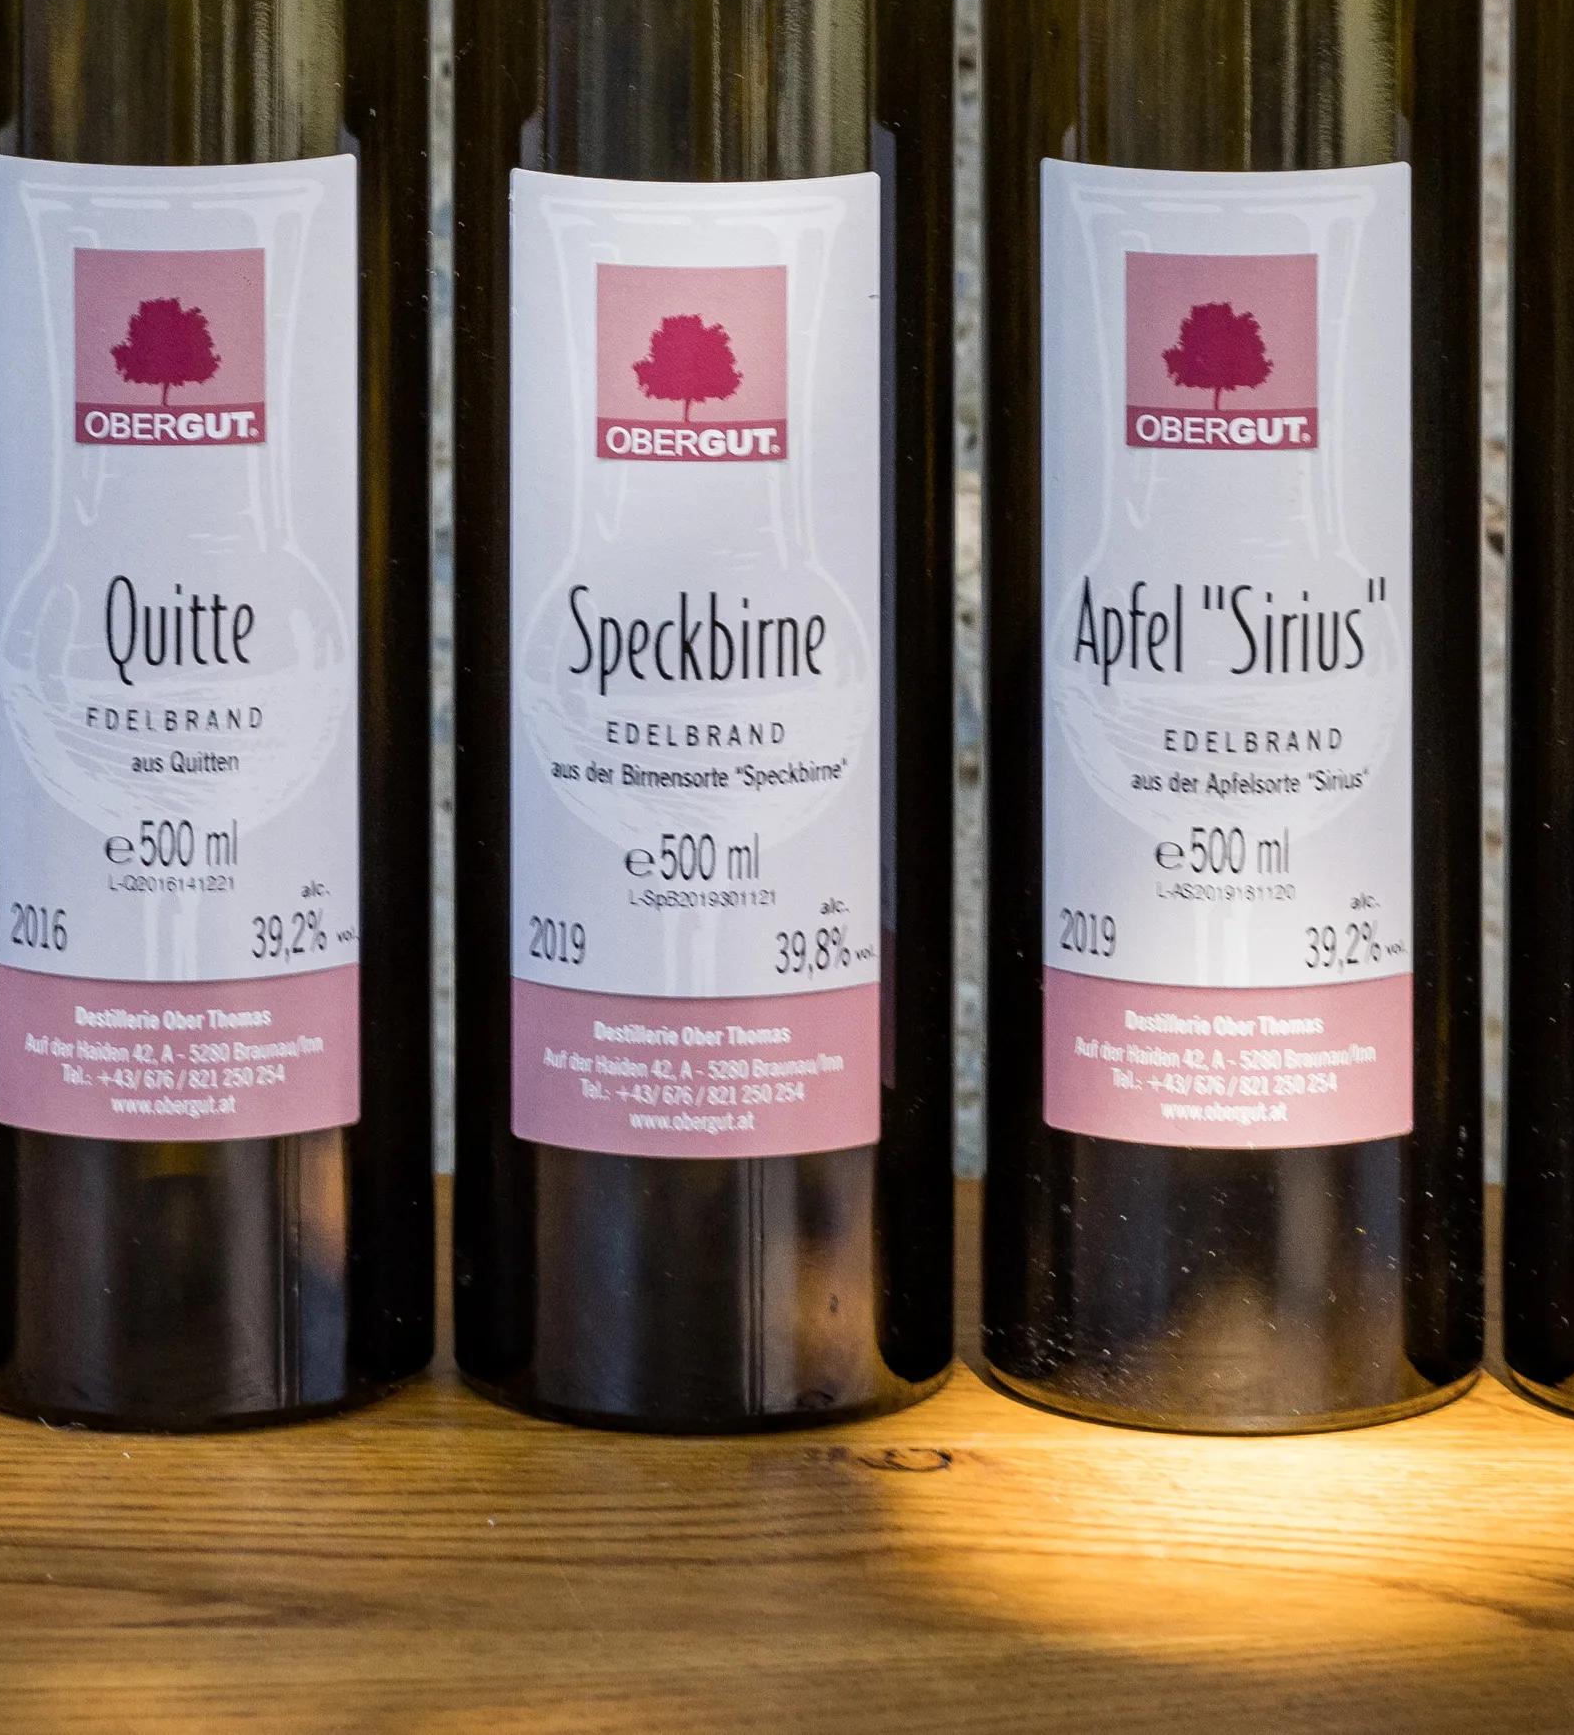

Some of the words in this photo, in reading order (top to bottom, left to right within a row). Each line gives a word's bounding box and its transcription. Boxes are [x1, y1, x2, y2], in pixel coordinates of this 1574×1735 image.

[106, 575, 254, 686] Quitte
[569, 584, 826, 696] Speckbirne
[1074, 575, 1183, 686] Apfel
[606, 721, 786, 747] EDELBRAND
[1164, 728, 1343, 753] EDELBRAND
[131, 756, 163, 773] aus
[170, 751, 239, 774] Quitten
[551, 760, 580, 780] aus
[586, 761, 615, 784] der
[622, 763, 729, 788] Birnensorte
[1131, 772, 1162, 791] aus
[1169, 773, 1198, 794] der
[1206, 773, 1300, 798] Apfelsorte
[206, 819, 237, 866] ml
[728, 832, 759, 880] ml
[1257, 826, 1289, 874] ml
[11, 902, 67, 952] 2016
[253, 909, 327, 963] 39,2%
[529, 916, 586, 966] 2019
[1060, 907, 1117, 958] 2019
[1305, 919, 1381, 974] 39,2%
[776, 924, 851, 980] 39,8%
[208, 1007, 271, 1028] Thomas
[726, 1026, 791, 1045] Thomas
[1259, 1015, 1324, 1036] Thomas
